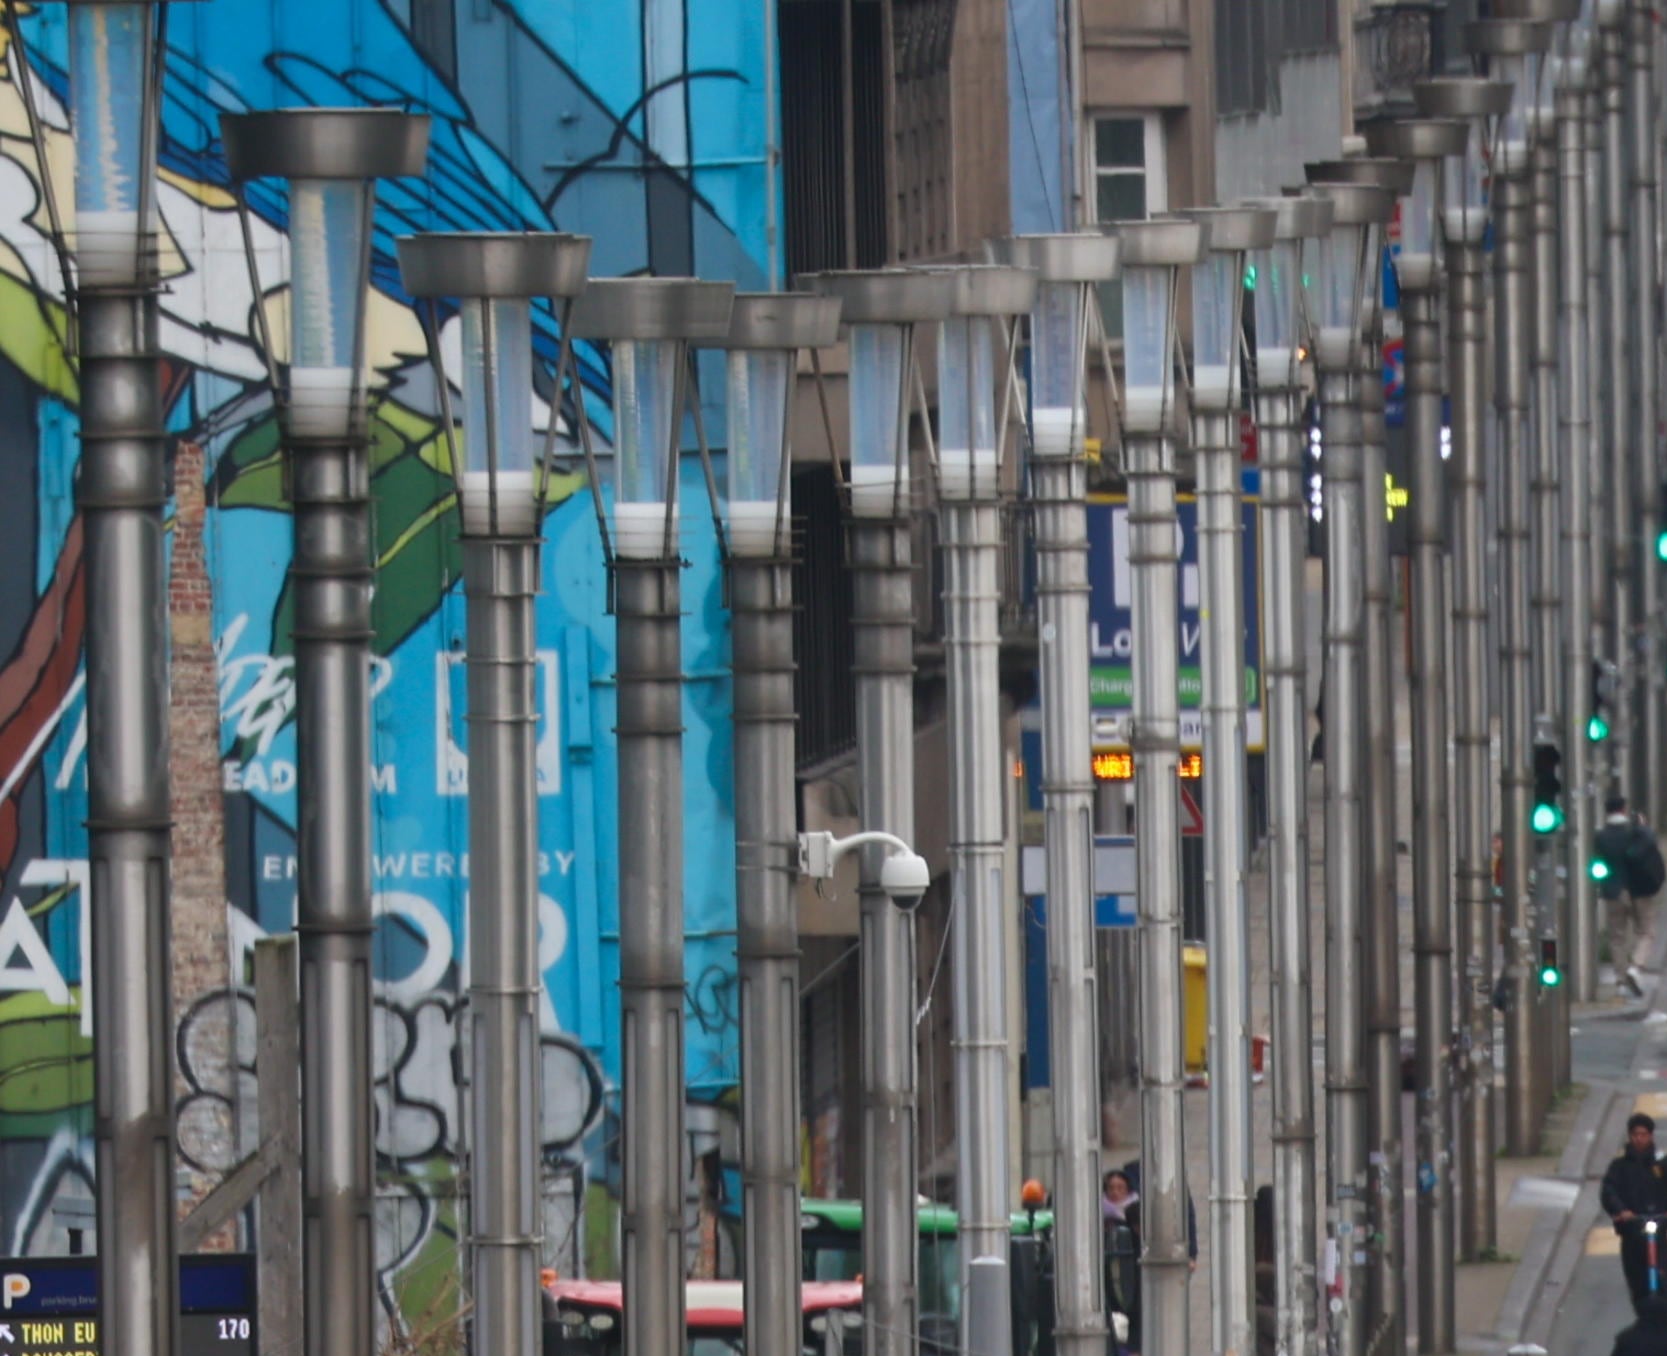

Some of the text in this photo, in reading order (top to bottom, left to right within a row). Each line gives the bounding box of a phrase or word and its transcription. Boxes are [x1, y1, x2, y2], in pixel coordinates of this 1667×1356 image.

[1091, 622, 1131, 656] Lo
[41, 1295, 97, 1307] parking.bru
[22, 1323, 64, 1344] THON
[218, 1318, 250, 1340] 170
